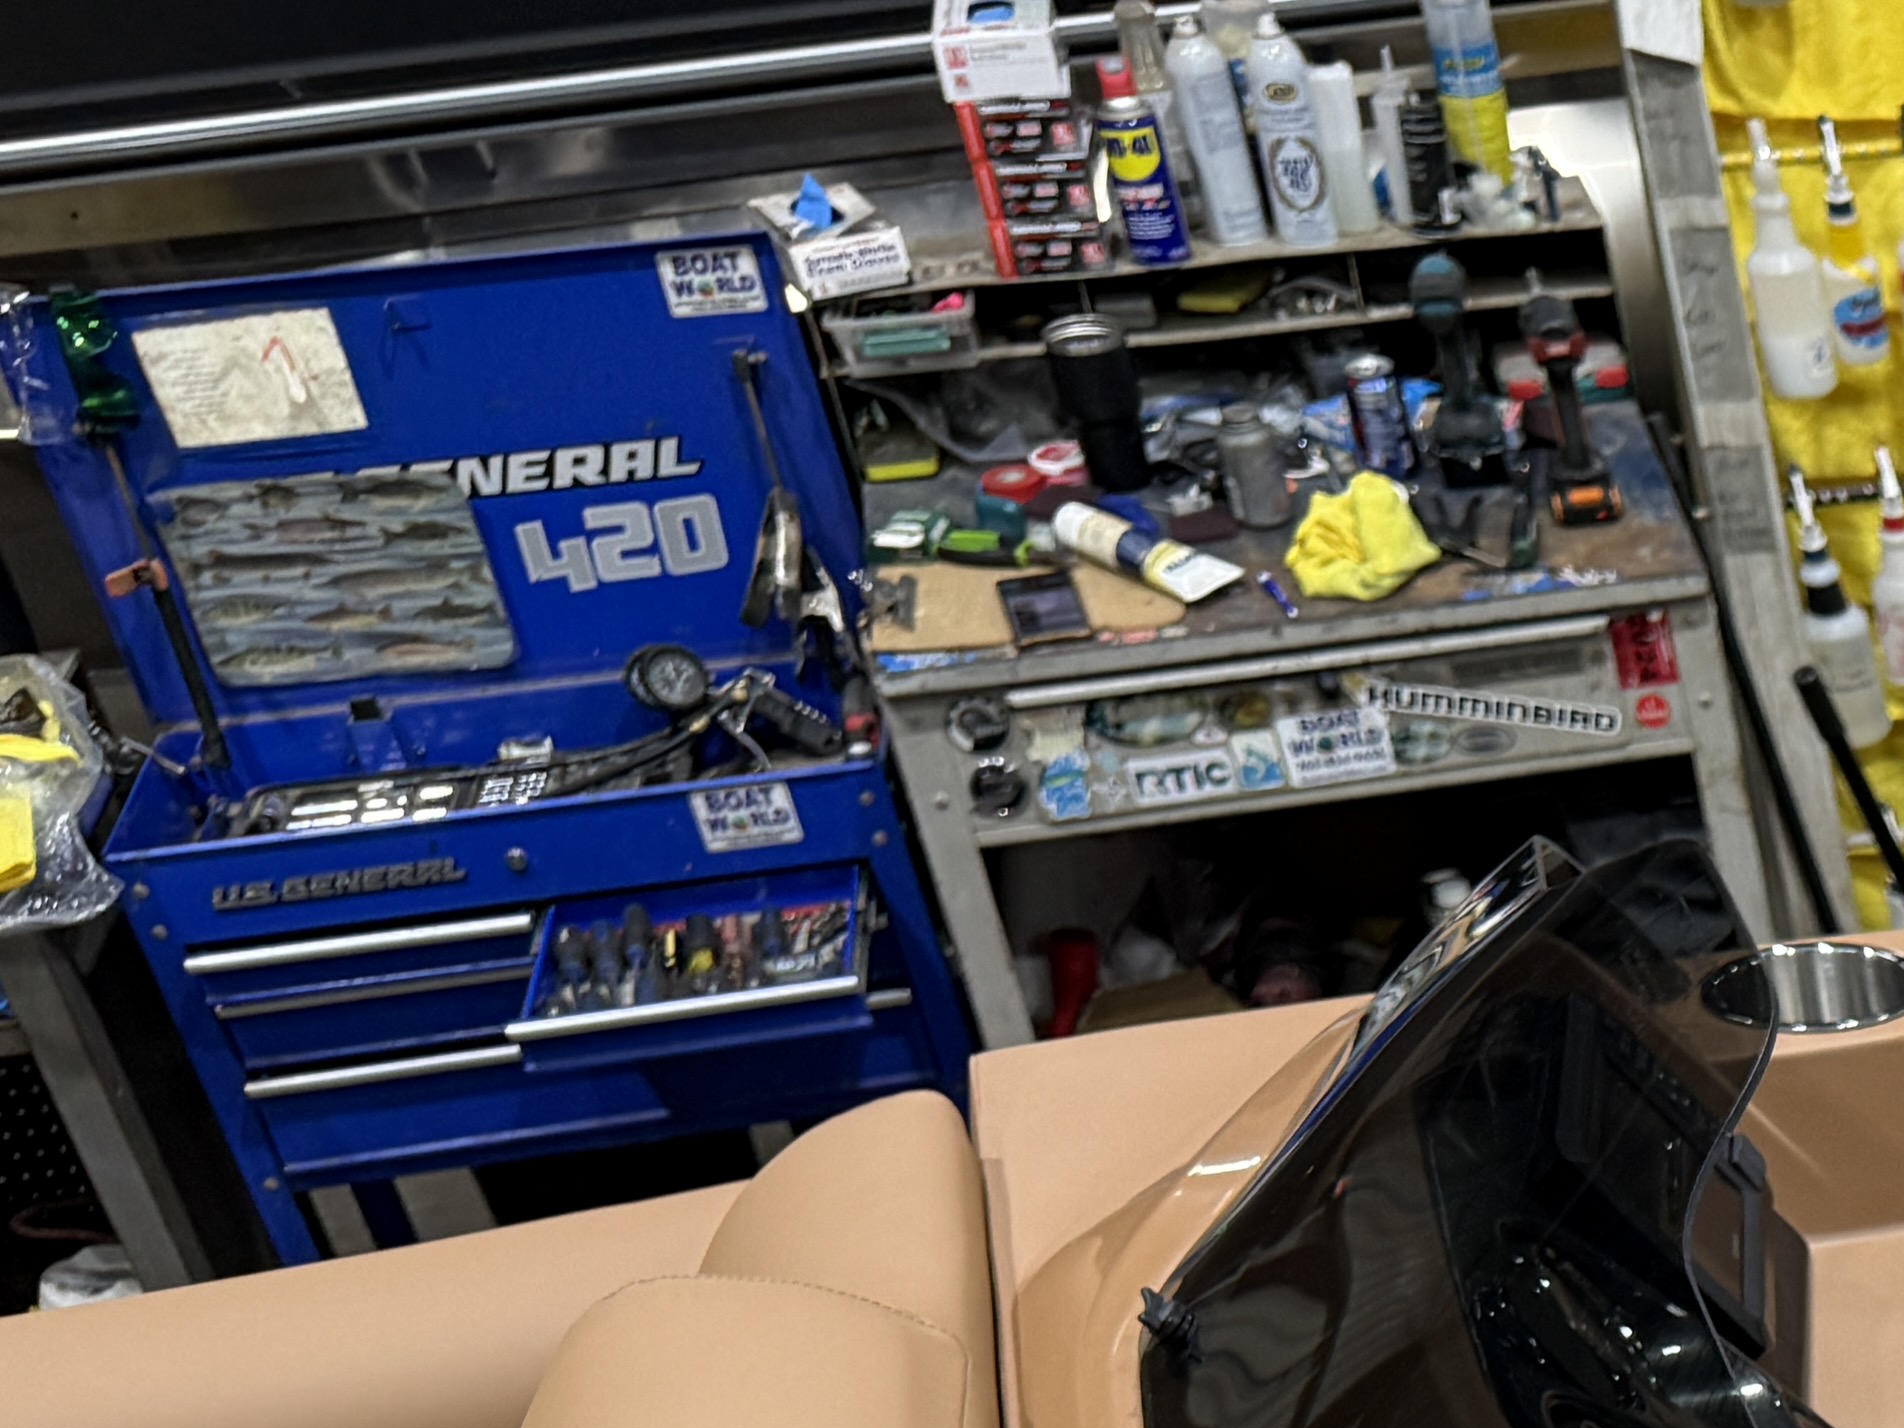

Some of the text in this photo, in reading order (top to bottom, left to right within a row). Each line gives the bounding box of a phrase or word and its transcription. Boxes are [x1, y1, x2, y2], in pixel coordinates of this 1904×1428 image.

[671, 253, 739, 276] BOAT
[513, 492, 729, 593] 420
[1300, 710, 1358, 735] BOAT
[1367, 685, 1617, 735] HUMMINBIRD
[1135, 762, 1231, 797] RTIC
[705, 786, 773, 813] BOAT
[280, 856, 467, 902] GENERAL
